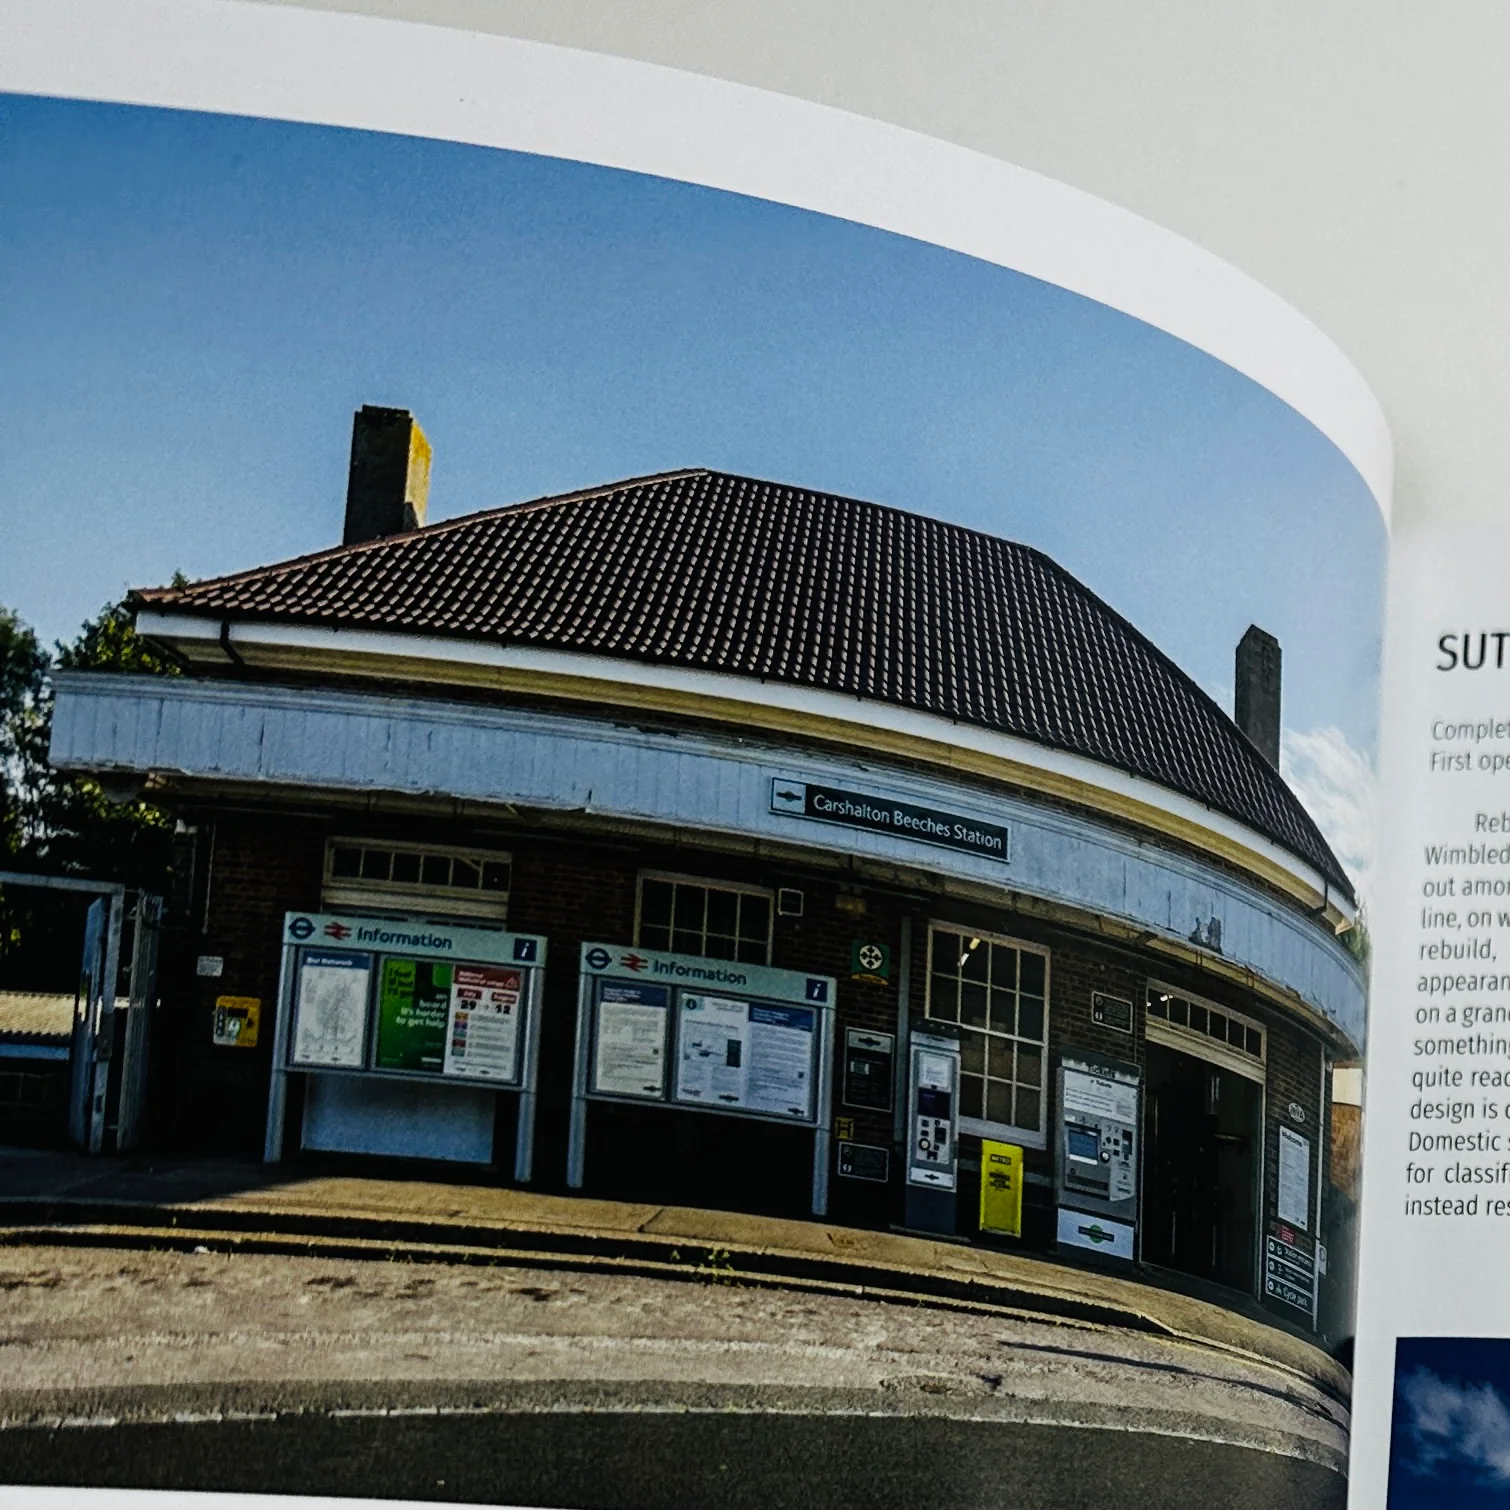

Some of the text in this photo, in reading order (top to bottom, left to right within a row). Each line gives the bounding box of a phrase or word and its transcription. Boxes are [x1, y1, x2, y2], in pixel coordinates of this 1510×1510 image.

[1431, 751, 1471, 772] First
[813, 793, 1003, 851] Carshalton Beeches Station
[356, 927, 453, 950] Information
[652, 959, 748, 986] Information
[1405, 1194, 1478, 1217] instead
